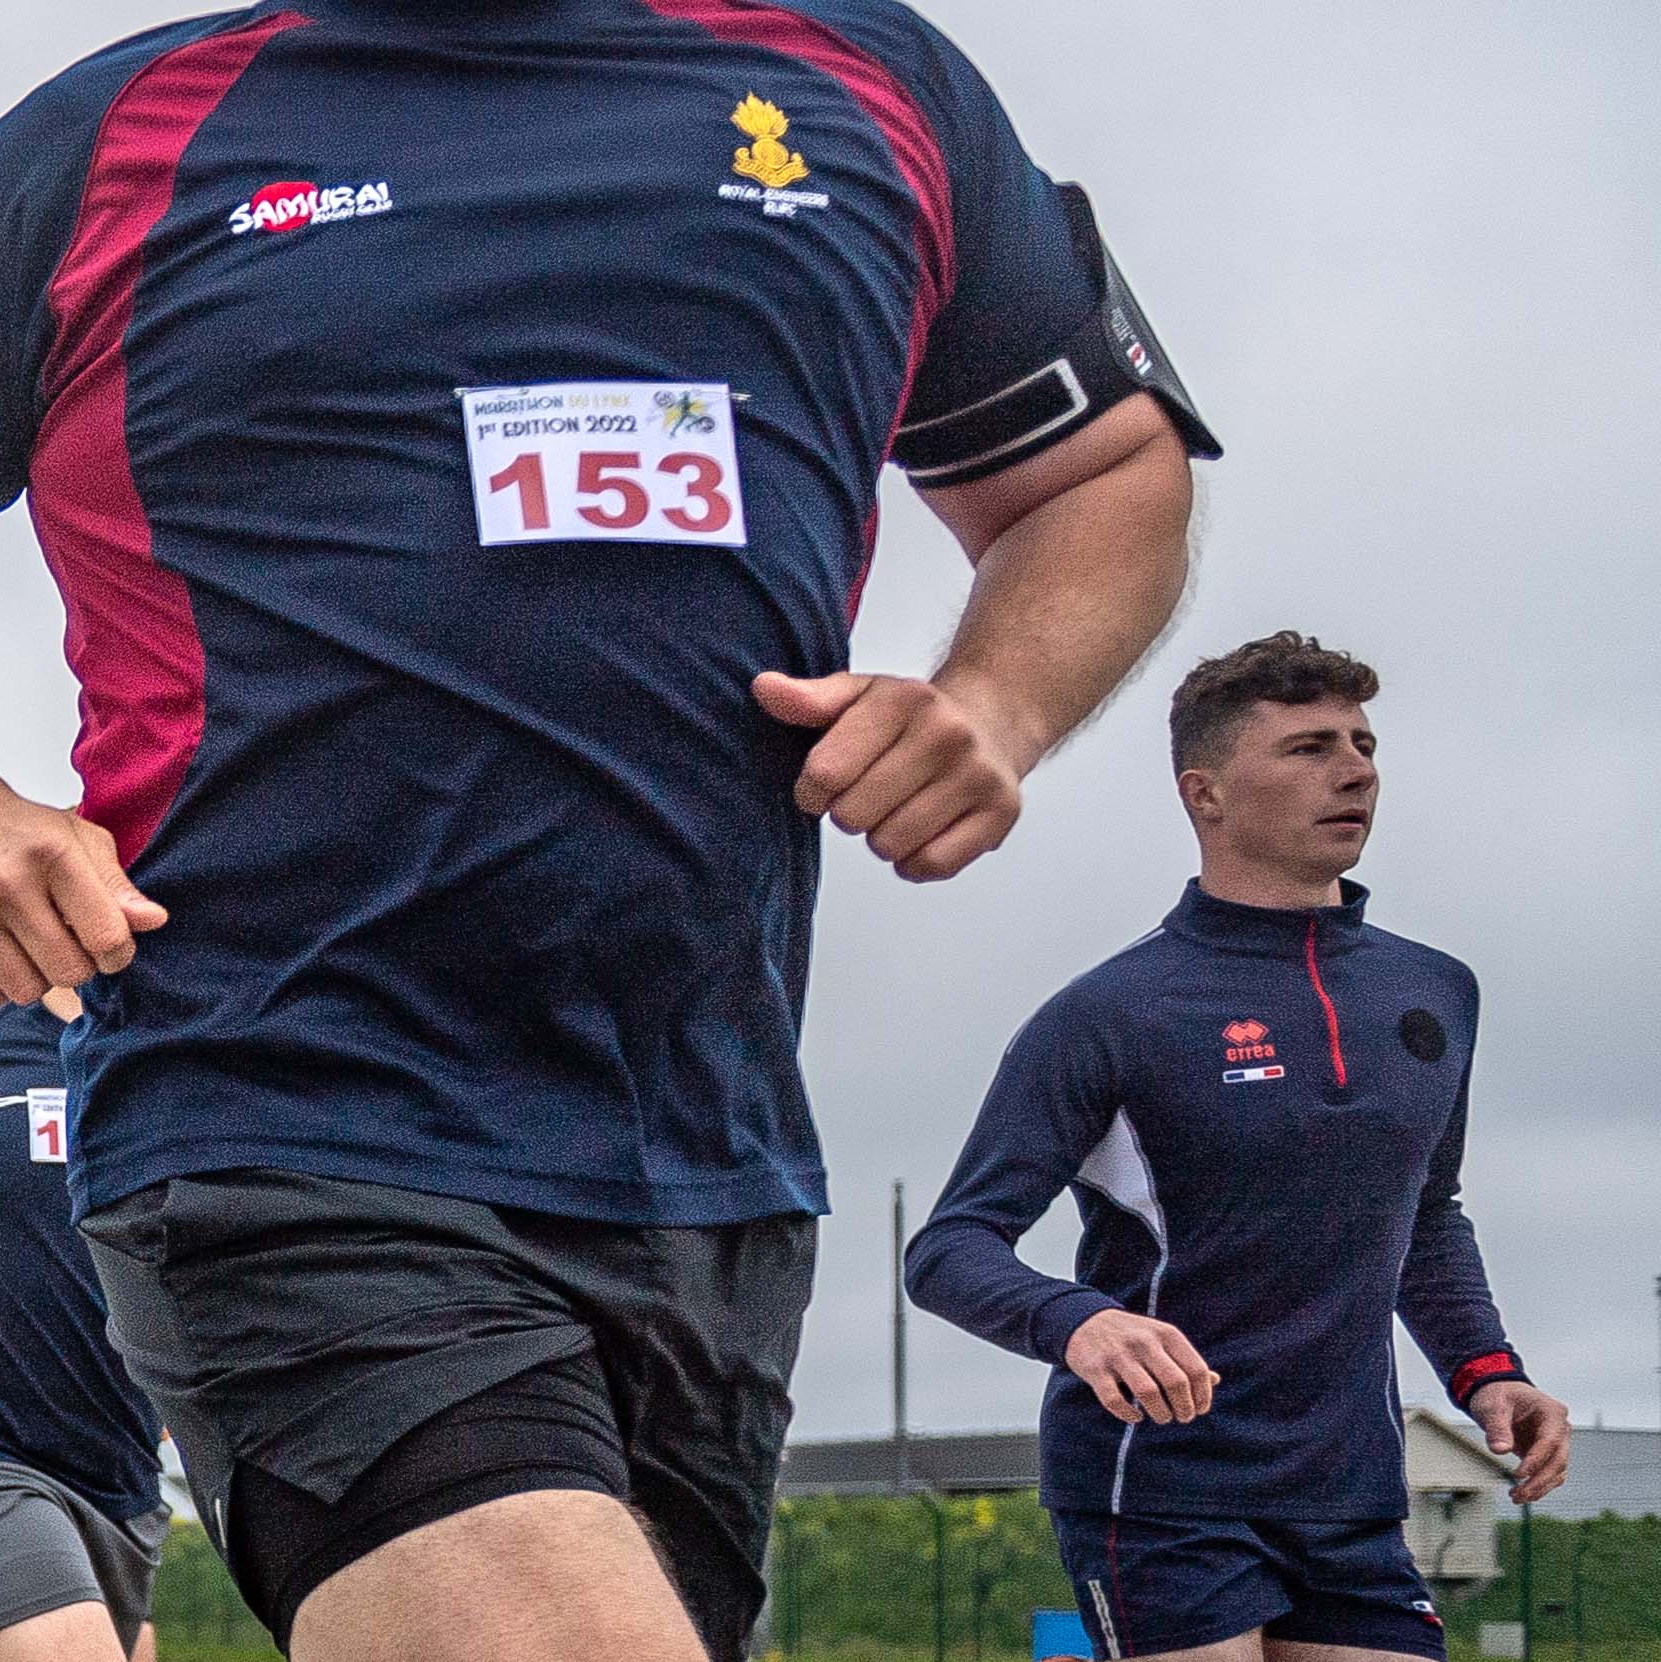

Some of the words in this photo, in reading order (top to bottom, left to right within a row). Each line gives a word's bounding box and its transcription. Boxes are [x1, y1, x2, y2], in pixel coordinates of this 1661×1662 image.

[229, 182, 390, 234] SAMURAI
[474, 395, 564, 416] MARATHON
[502, 416, 580, 438] EDITION
[585, 414, 637, 433] 2022
[489, 451, 732, 532] 153
